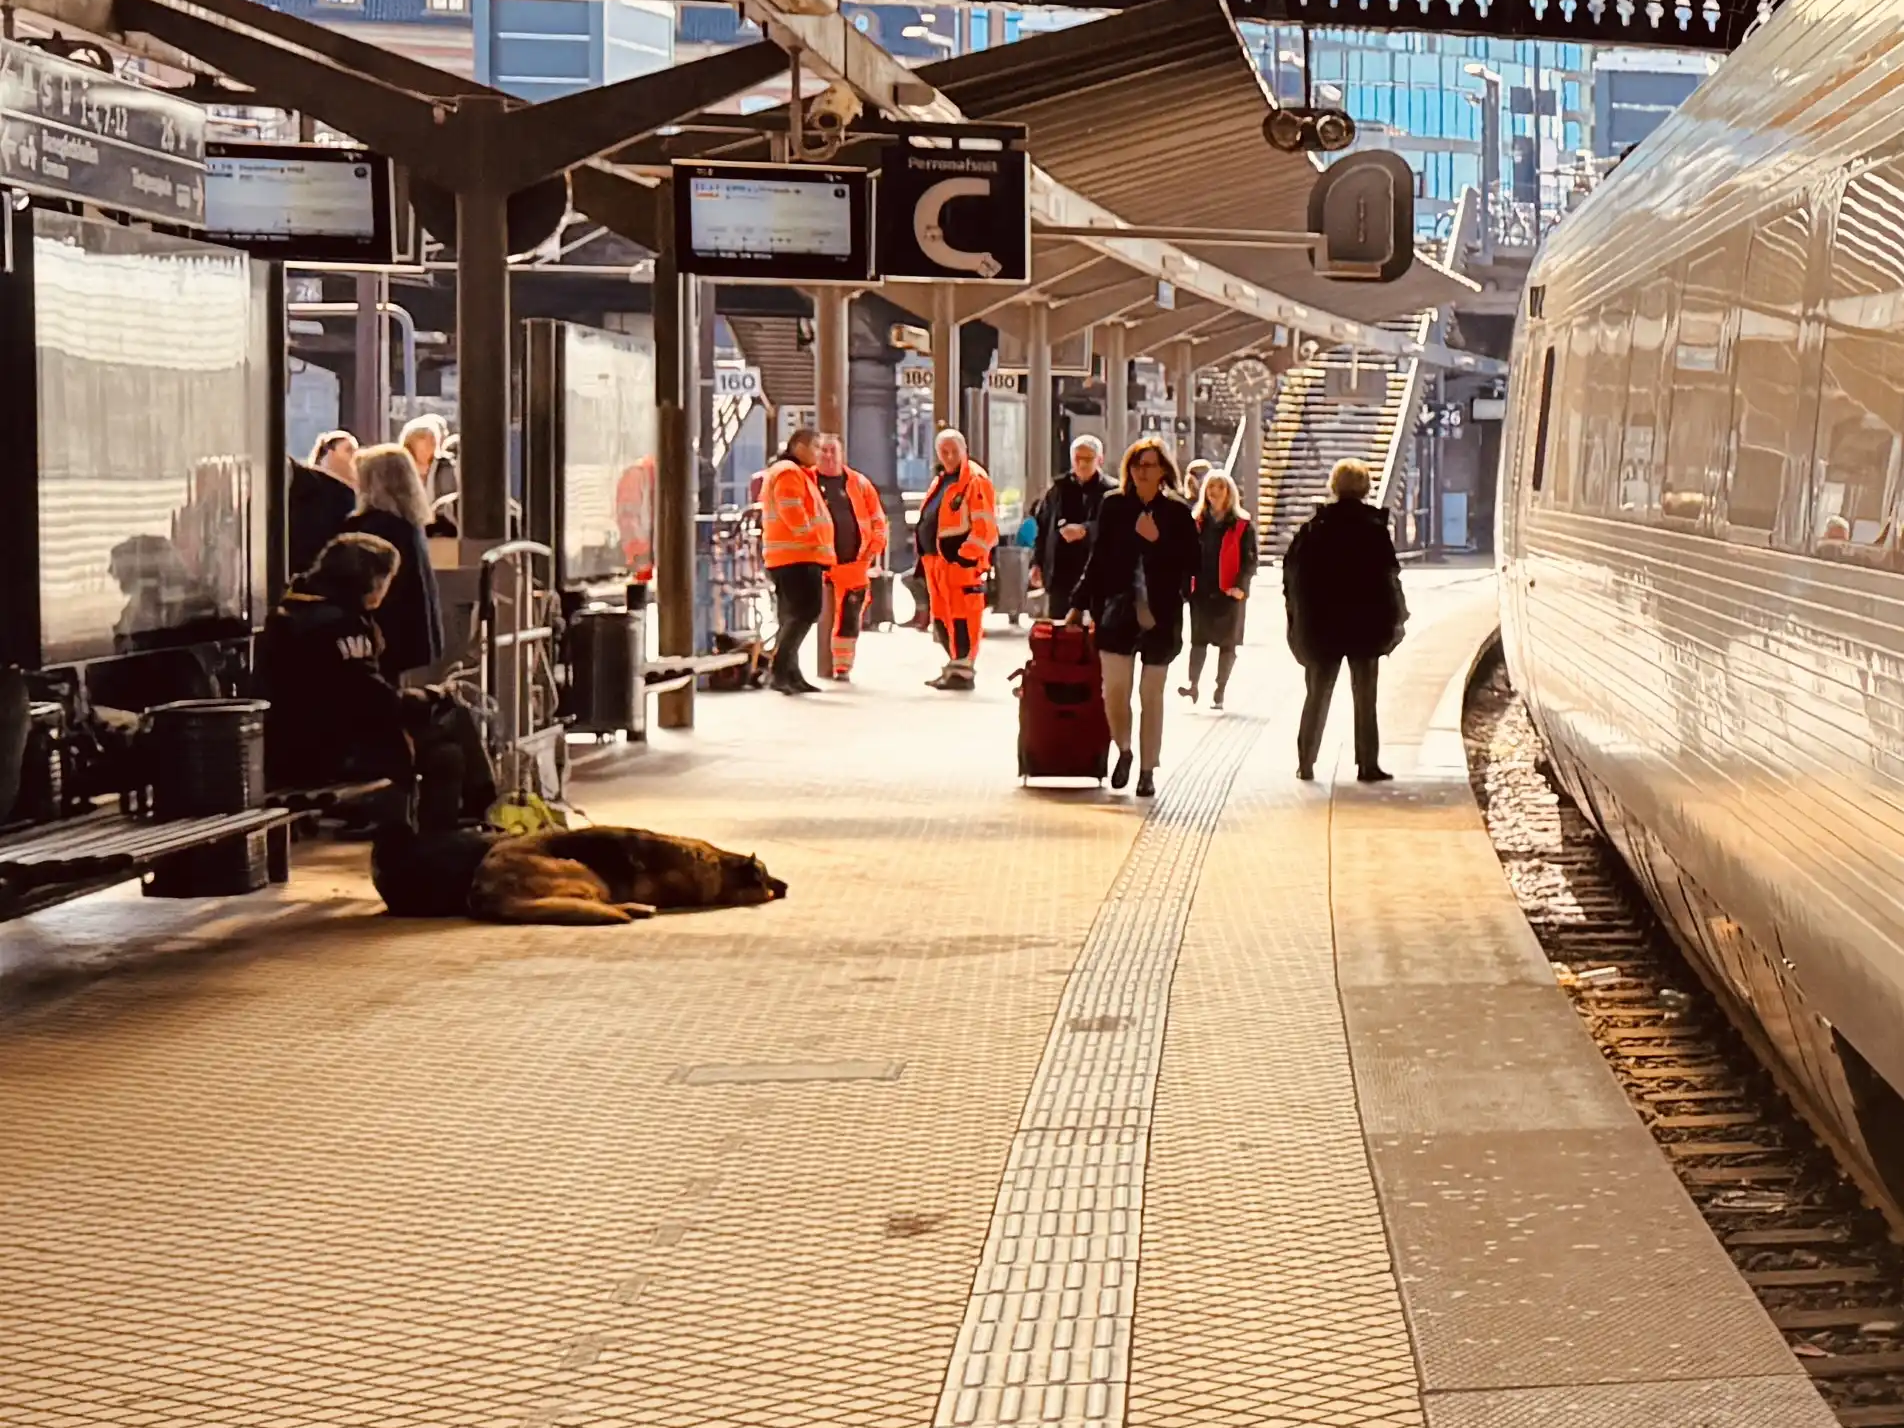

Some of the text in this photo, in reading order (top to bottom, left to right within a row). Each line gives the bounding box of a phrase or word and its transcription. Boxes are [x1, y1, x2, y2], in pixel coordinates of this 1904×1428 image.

[913, 176, 993, 273] C
[721, 373, 756, 390] 160
[1440, 410, 1461, 426] 26
